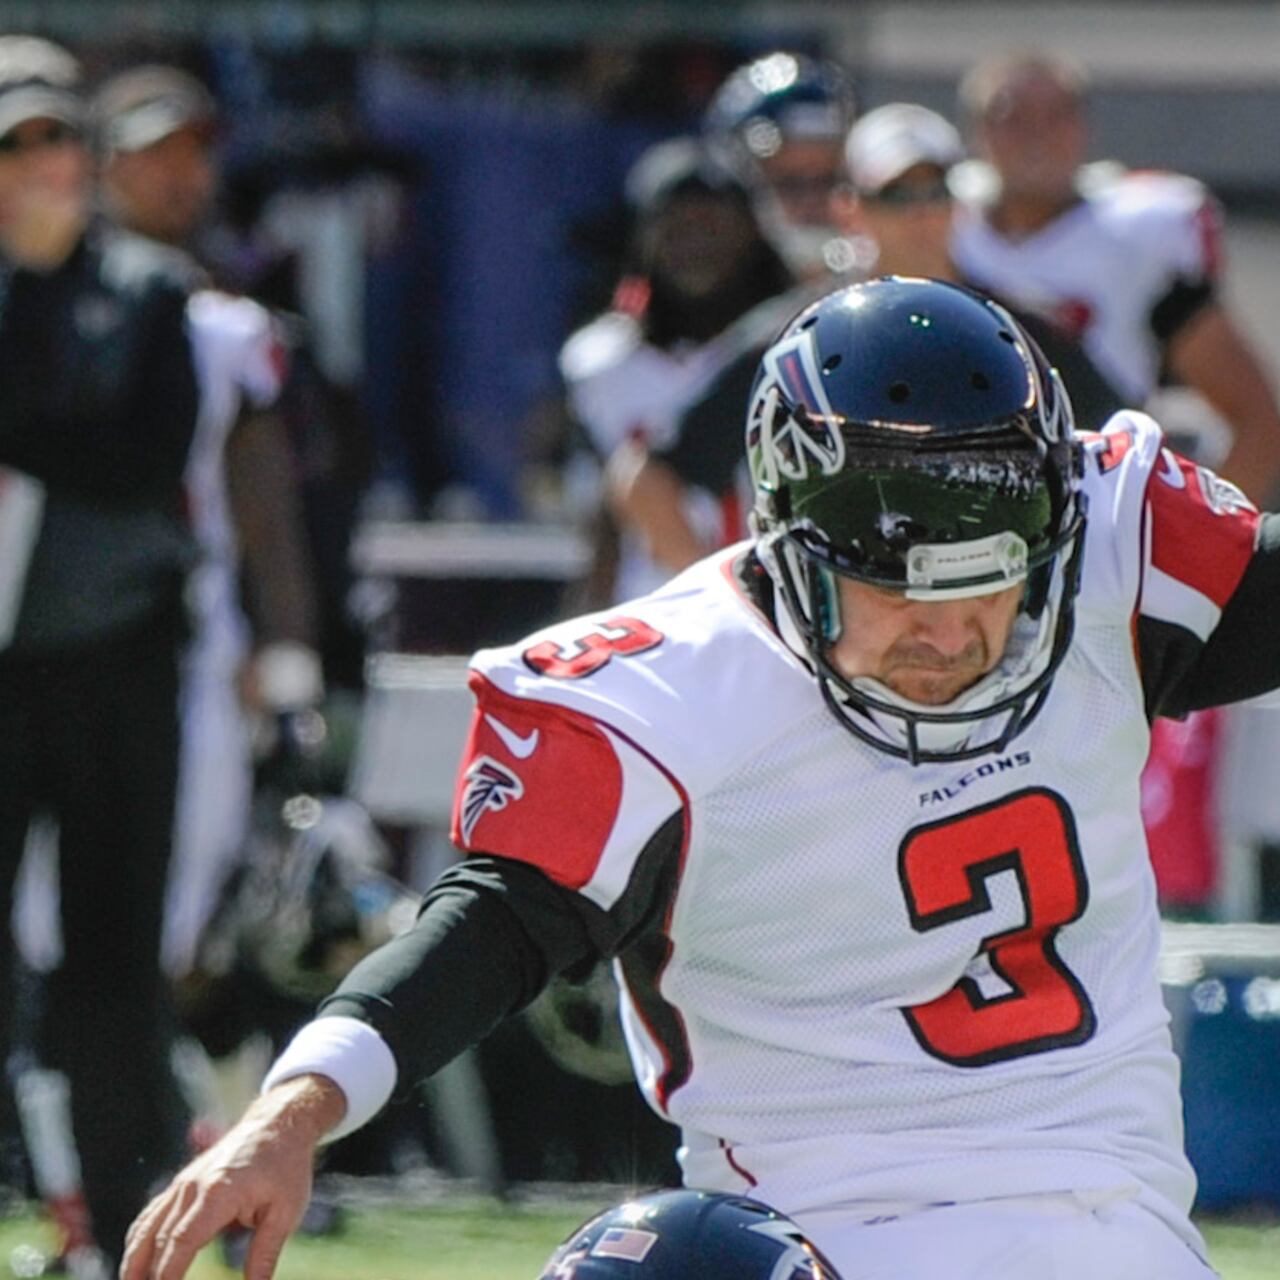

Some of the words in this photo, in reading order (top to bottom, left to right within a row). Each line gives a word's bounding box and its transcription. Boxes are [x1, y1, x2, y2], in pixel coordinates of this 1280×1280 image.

[521, 614, 666, 680] 3
[919, 751, 1032, 807] FALCONS
[897, 785, 1098, 1068] 3
